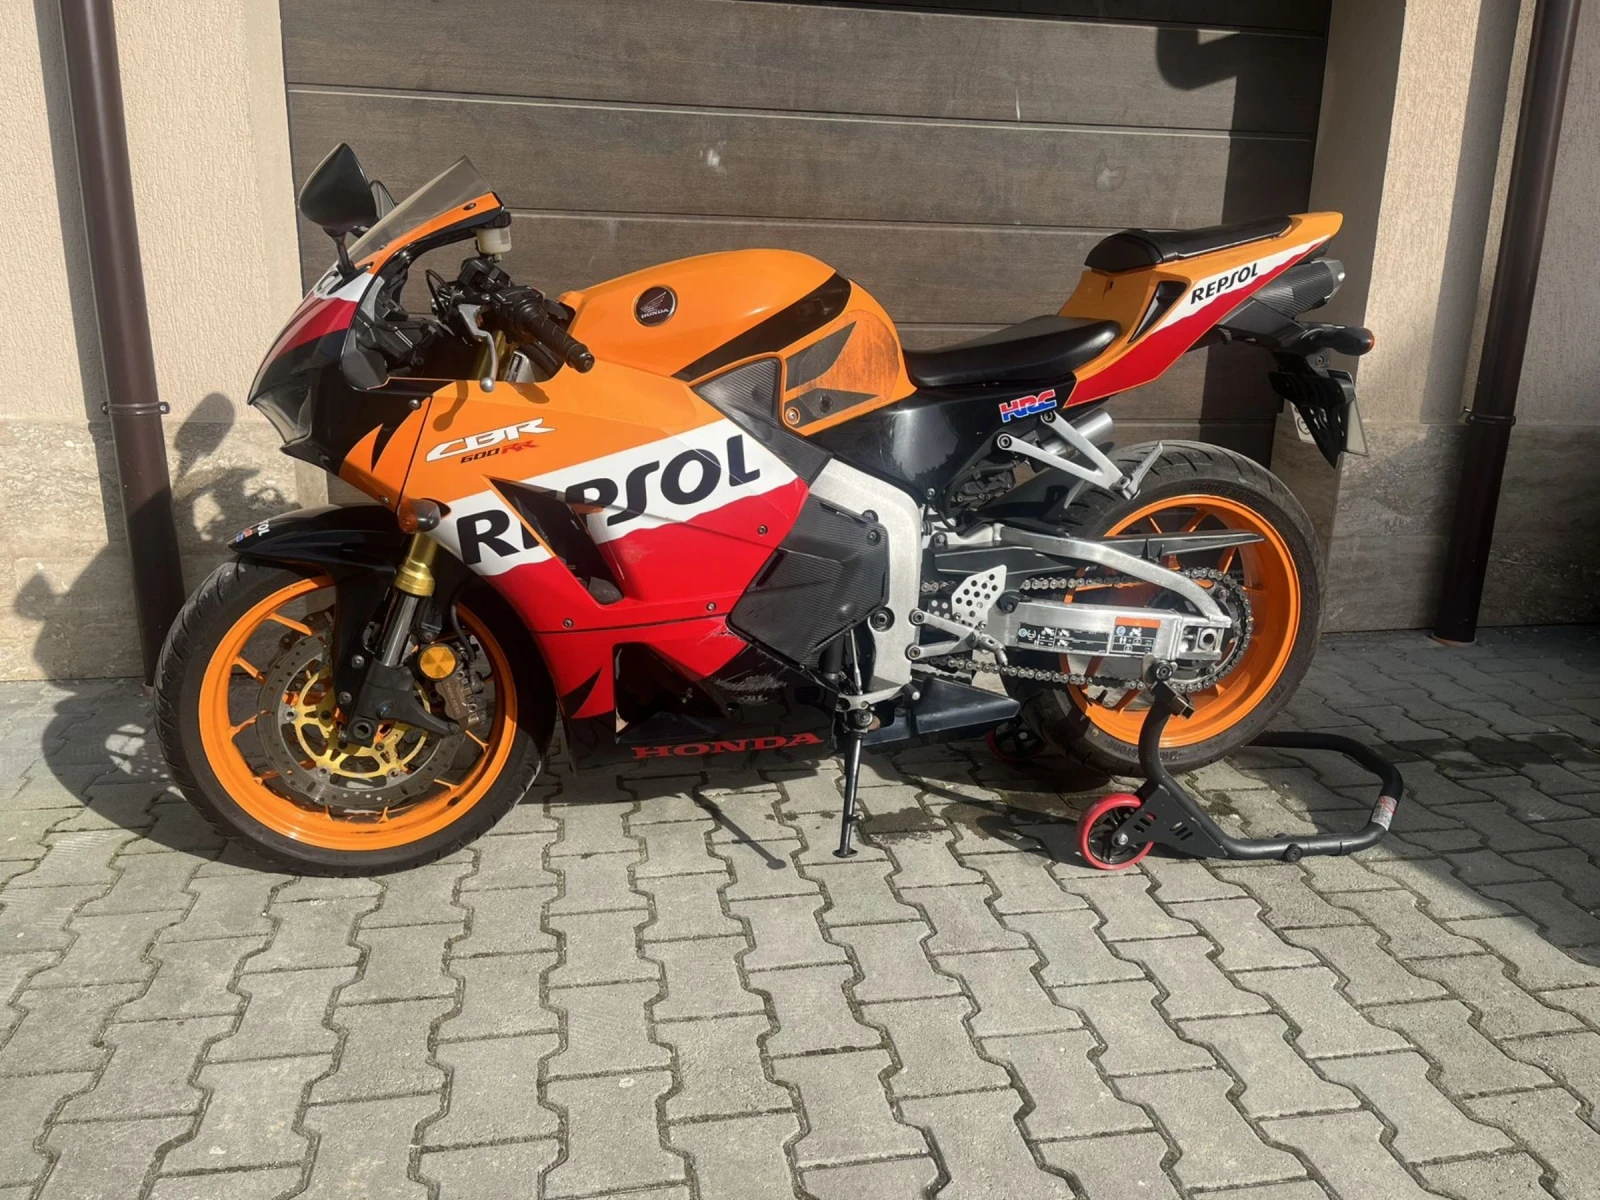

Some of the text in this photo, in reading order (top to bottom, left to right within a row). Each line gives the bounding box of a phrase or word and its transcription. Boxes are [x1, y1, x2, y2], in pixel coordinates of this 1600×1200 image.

[1190, 262, 1258, 305] REPSOL
[640, 308, 669, 318] HONDA
[998, 388, 1057, 423] HRC
[426, 416, 557, 462] CBR
[460, 440, 540, 464] 600RR
[630, 731, 824, 759] HONDA
